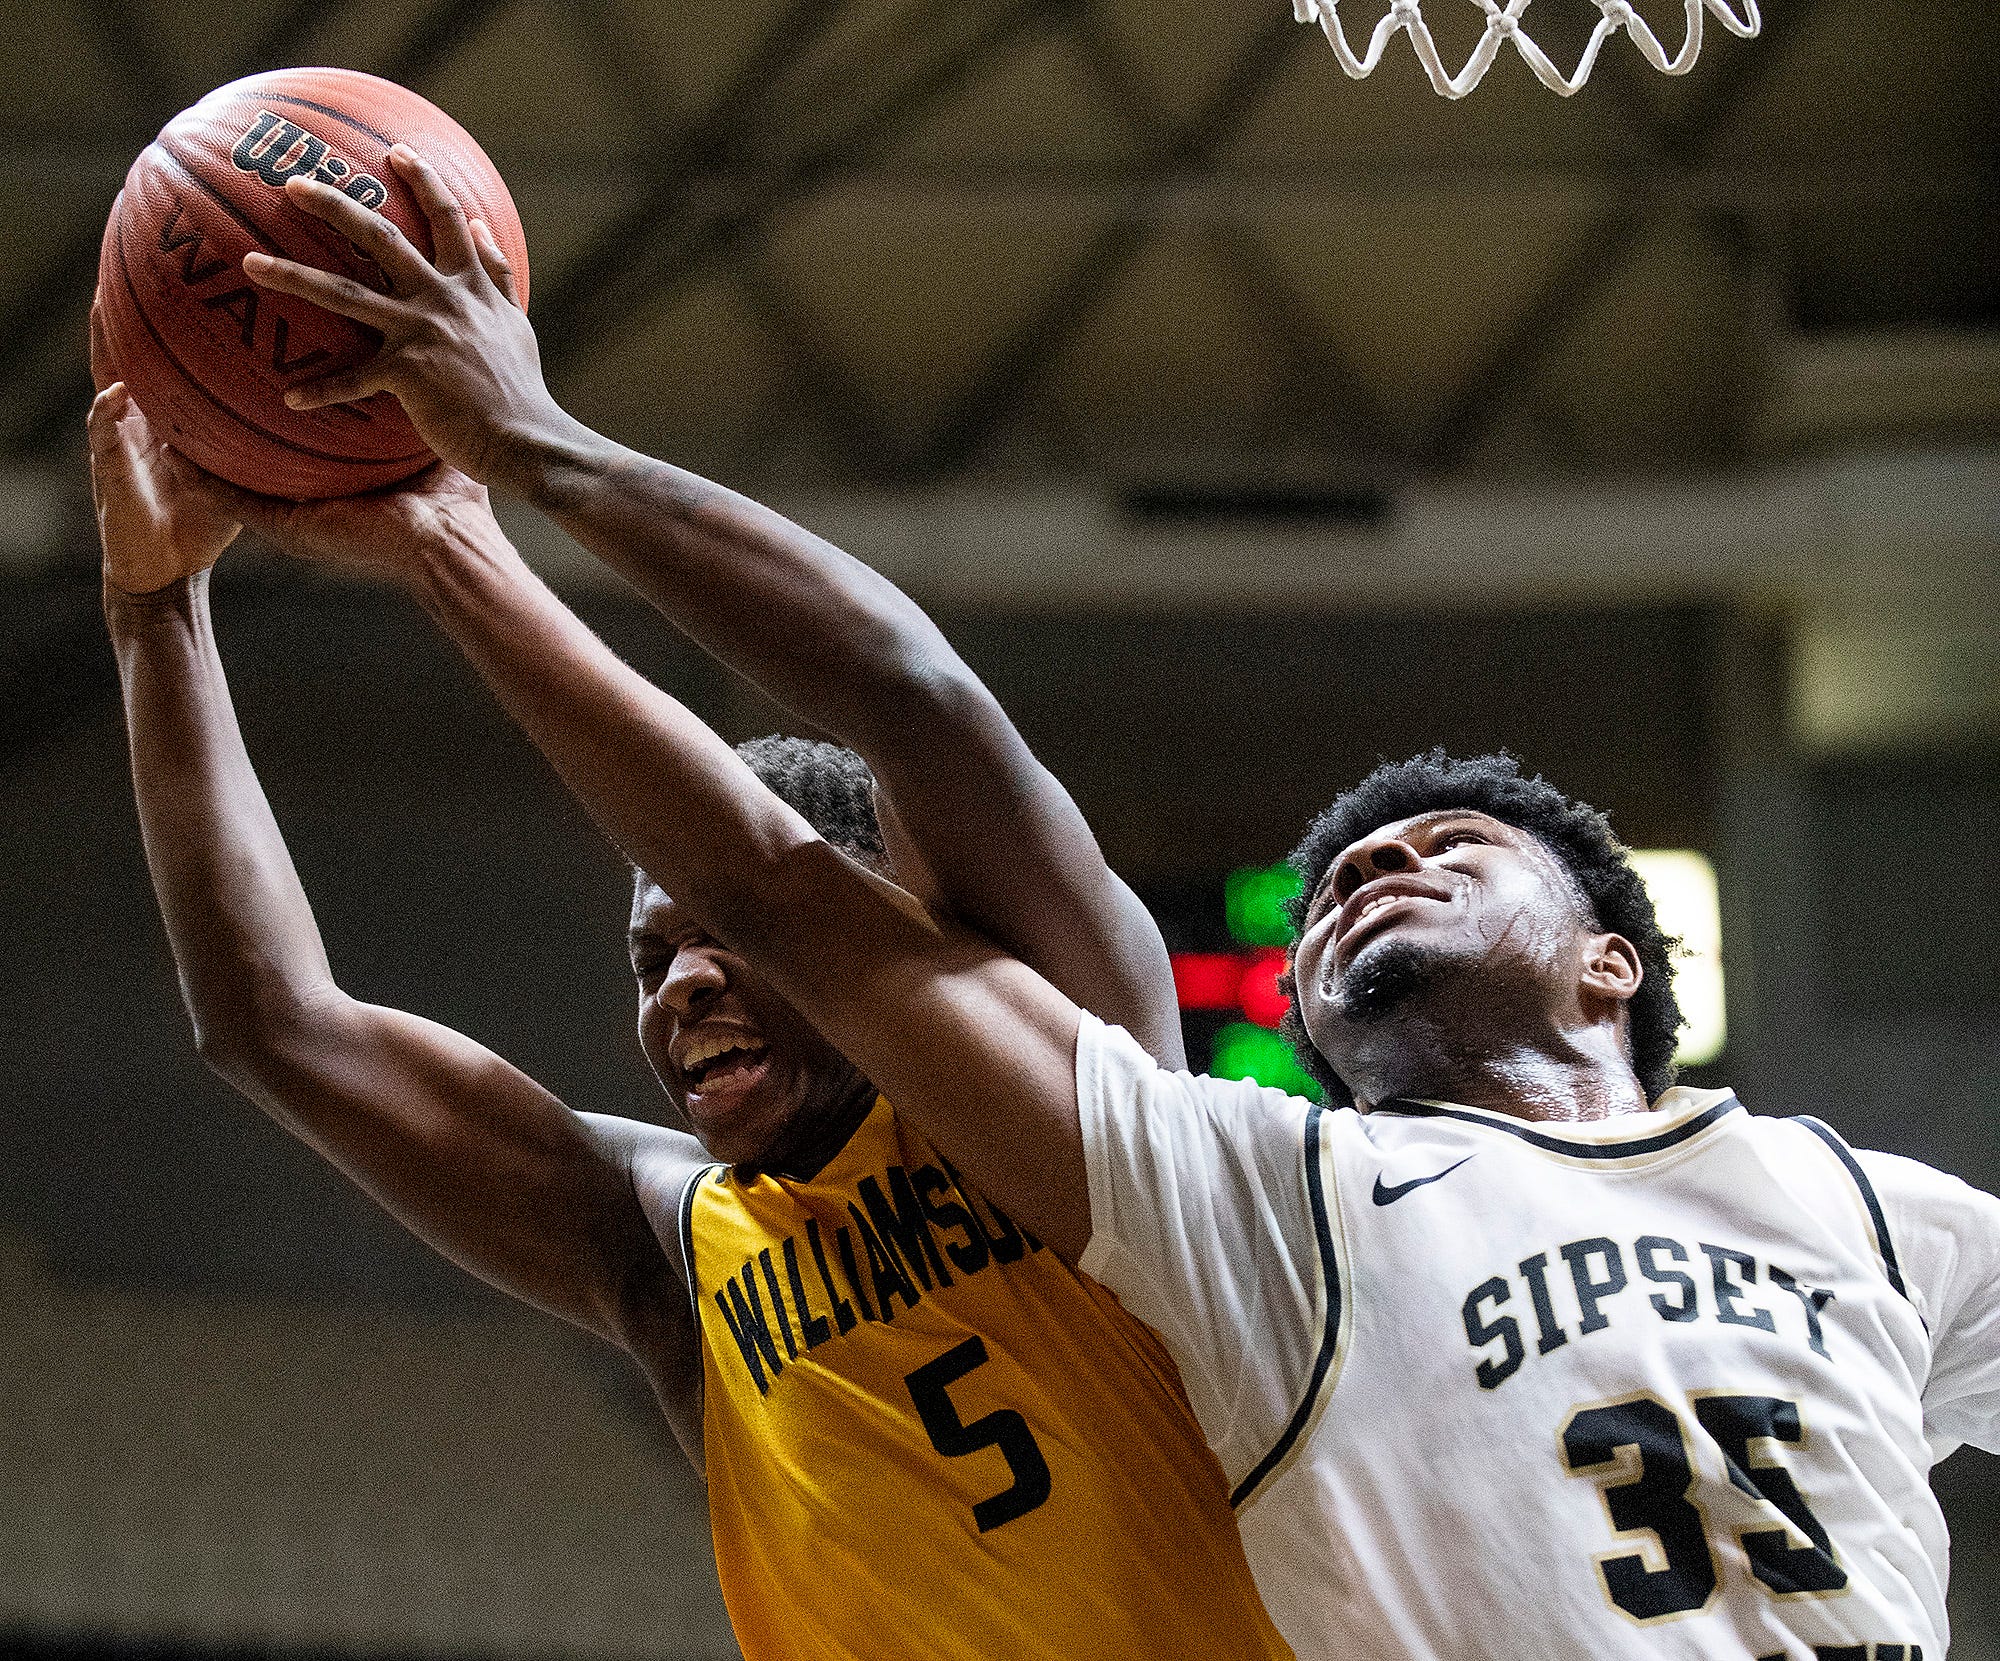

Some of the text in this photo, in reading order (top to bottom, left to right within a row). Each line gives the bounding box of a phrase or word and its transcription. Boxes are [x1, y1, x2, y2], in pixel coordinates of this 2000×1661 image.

[160, 196, 372, 421] WAV
[714, 1150, 1046, 1398] WILLIAMSO
[1460, 1234, 1837, 1391] SIPSEY
[903, 1334, 1052, 1534] 5
[1558, 1390, 1850, 1624] 35
